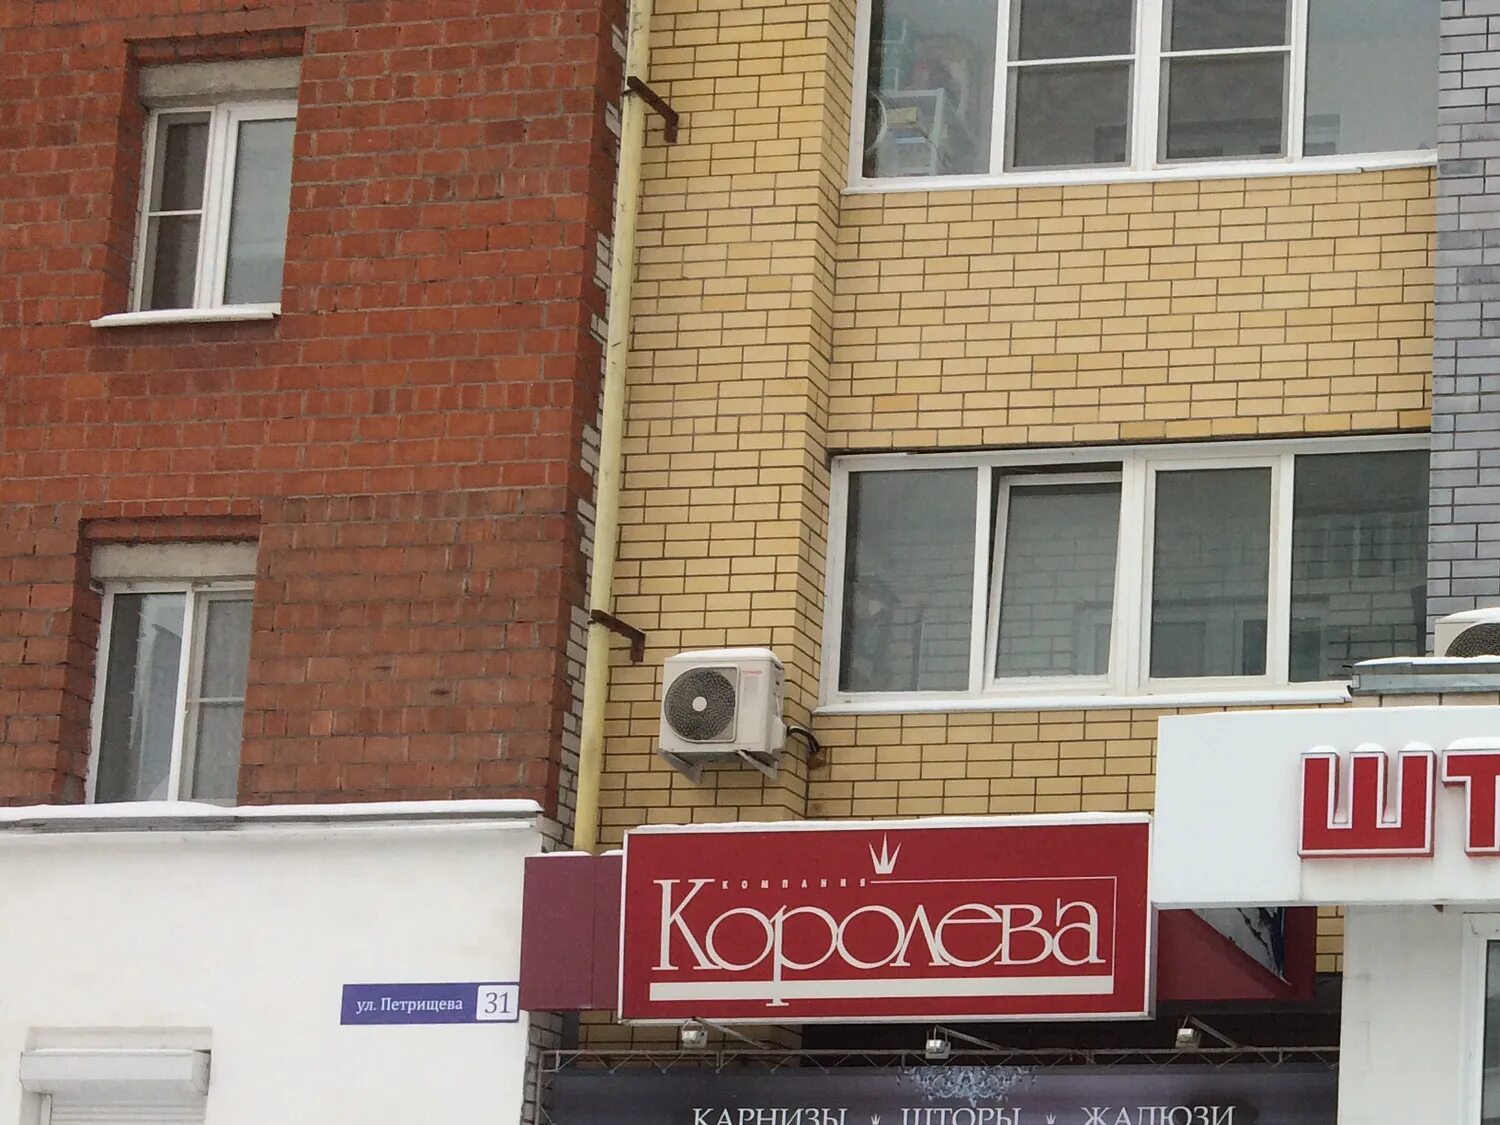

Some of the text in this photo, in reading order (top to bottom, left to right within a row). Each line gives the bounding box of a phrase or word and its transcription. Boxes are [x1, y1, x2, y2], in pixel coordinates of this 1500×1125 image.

[722, 878, 867, 890] КОМПАНИЯ
[652, 879, 1106, 1006] Королева
[356, 992, 511, 1014] ул. Петрищева 31
